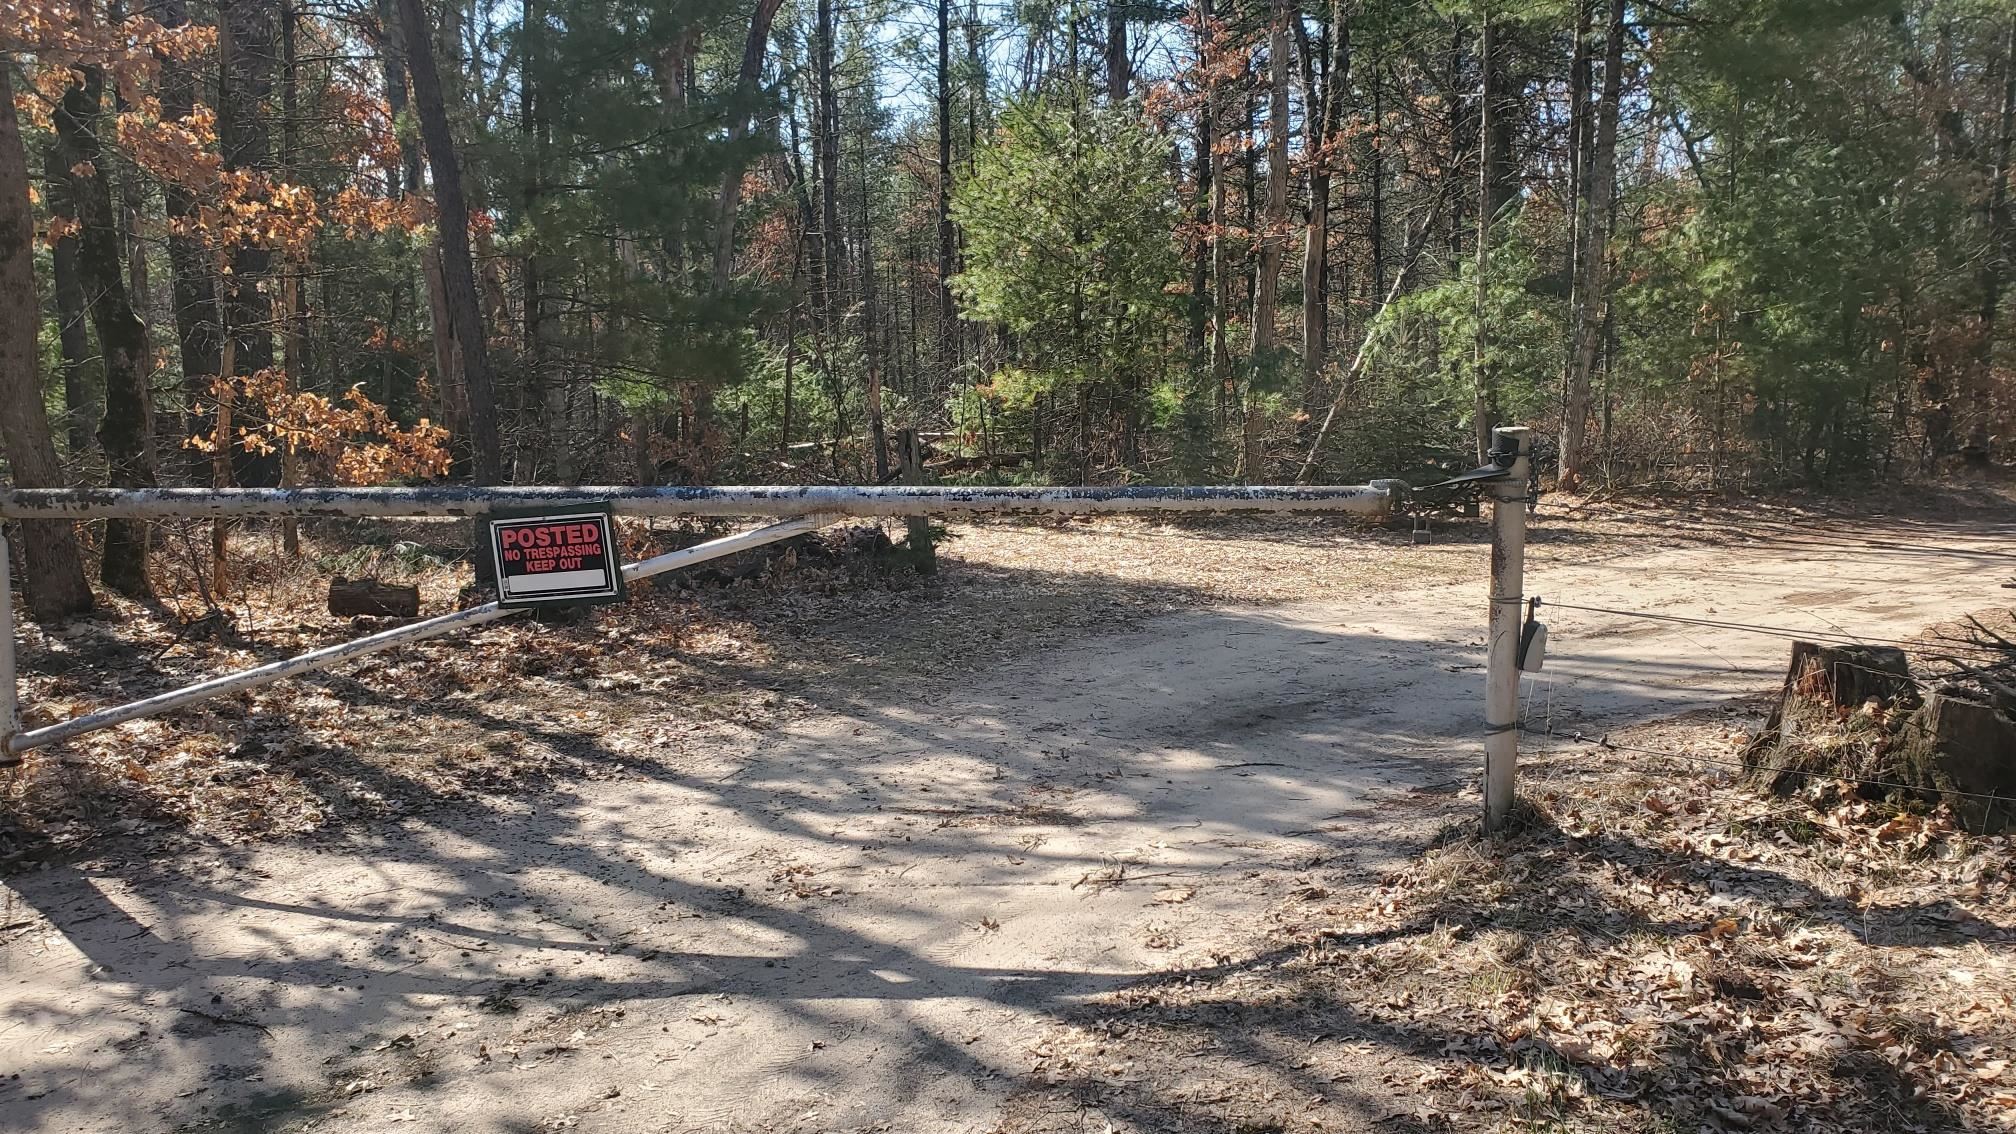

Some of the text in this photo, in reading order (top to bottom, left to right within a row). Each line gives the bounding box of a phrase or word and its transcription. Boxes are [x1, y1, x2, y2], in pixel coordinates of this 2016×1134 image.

[501, 524, 599, 548] POSTED
[504, 544, 602, 561] NO TRESPASSING
[526, 557, 582, 572] KEEP OUT
